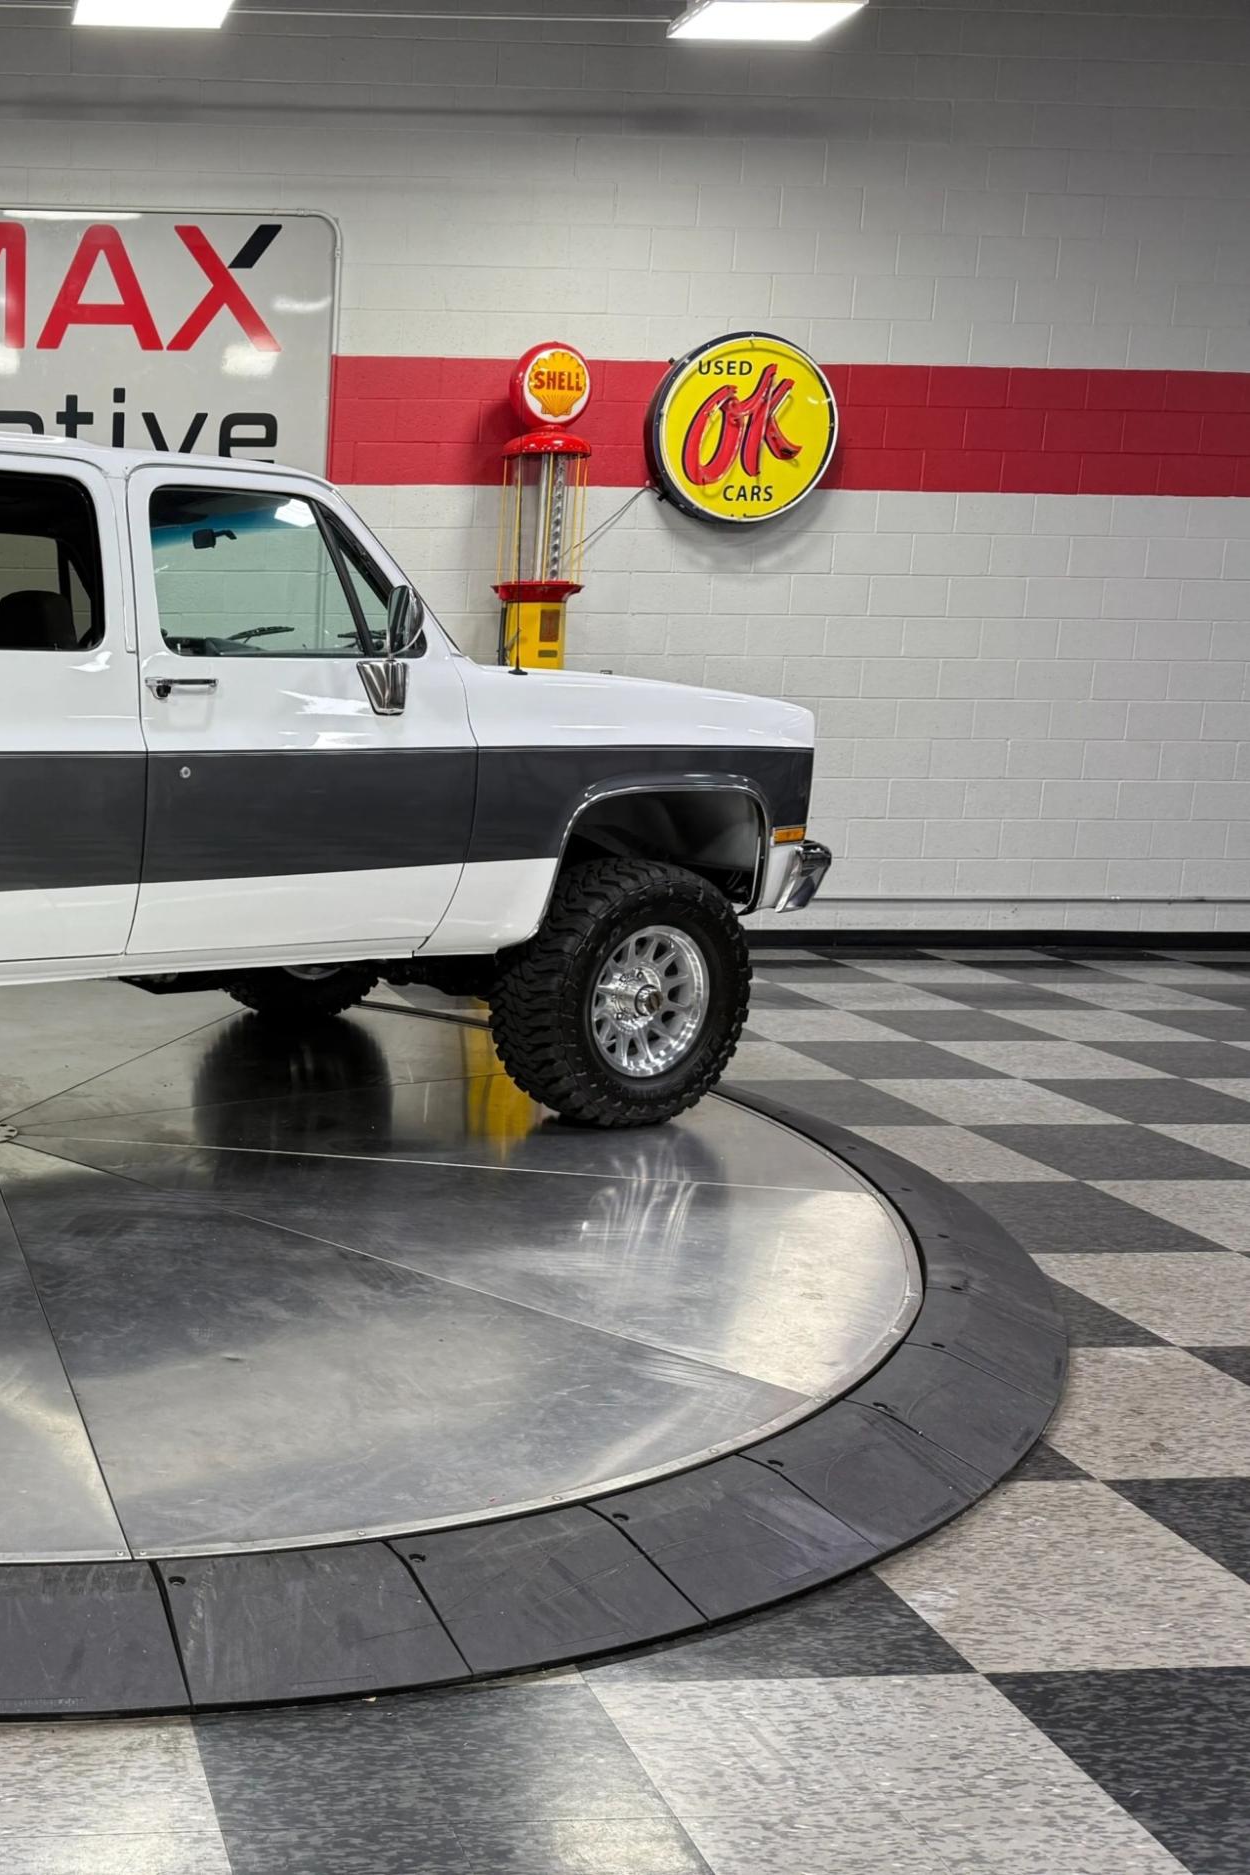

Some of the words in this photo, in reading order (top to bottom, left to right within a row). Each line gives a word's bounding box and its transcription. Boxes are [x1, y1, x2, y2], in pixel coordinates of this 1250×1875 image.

[698, 360, 753, 376] USED
[533, 370, 583, 392] SHELL
[682, 363, 803, 486] OK
[722, 485, 773, 502] CARS
